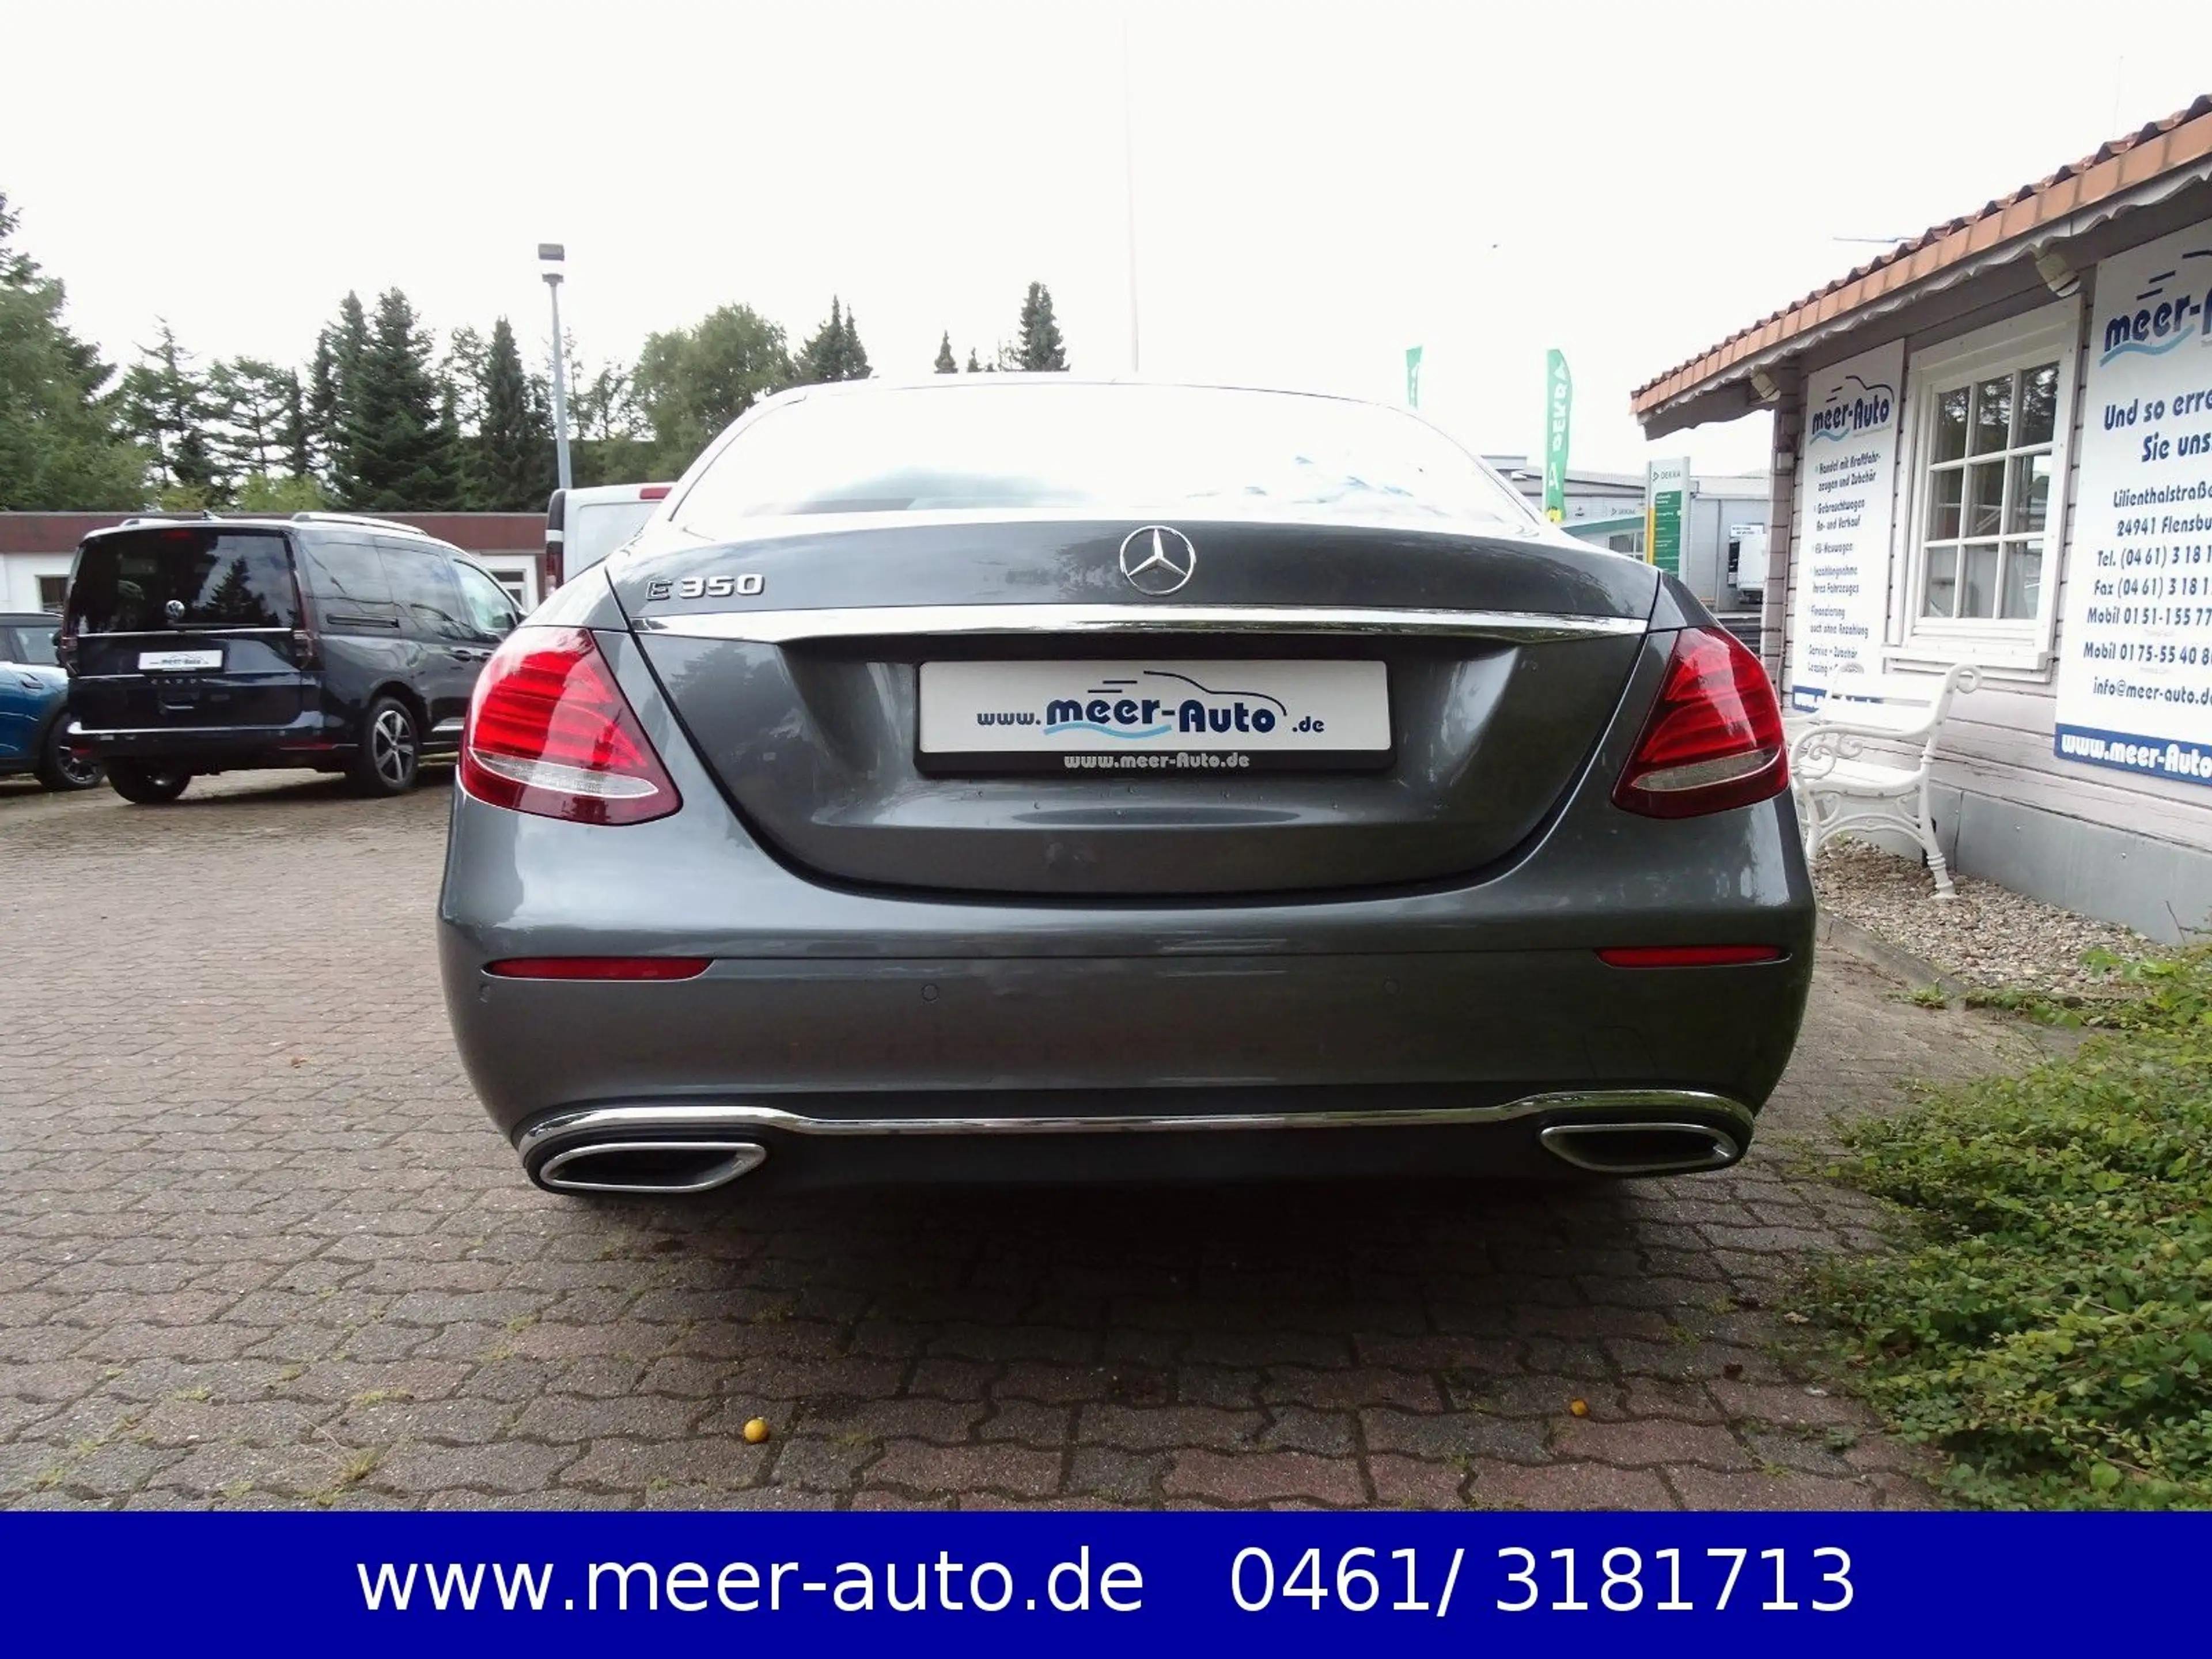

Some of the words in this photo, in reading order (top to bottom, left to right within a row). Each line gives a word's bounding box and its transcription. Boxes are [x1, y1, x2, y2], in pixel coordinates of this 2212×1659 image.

[1812, 394, 1890, 435] meer-Auto
[2104, 397, 2139, 431] Und
[2143, 400, 2165, 423] so
[2141, 431, 2171, 463] Sie
[2116, 517, 2156, 537] 24941
[2098, 550, 2116, 567] Tel.
[645, 579, 673, 601] E
[679, 574, 766, 599] 350
[2094, 579, 2113, 596] Fax
[2087, 607, 2120, 624] Mobil
[2083, 641, 2116, 660] Mobil
[1046, 699, 1276, 733] meer-Auto
[1064, 752, 1251, 769] www.meer-Auto.de
